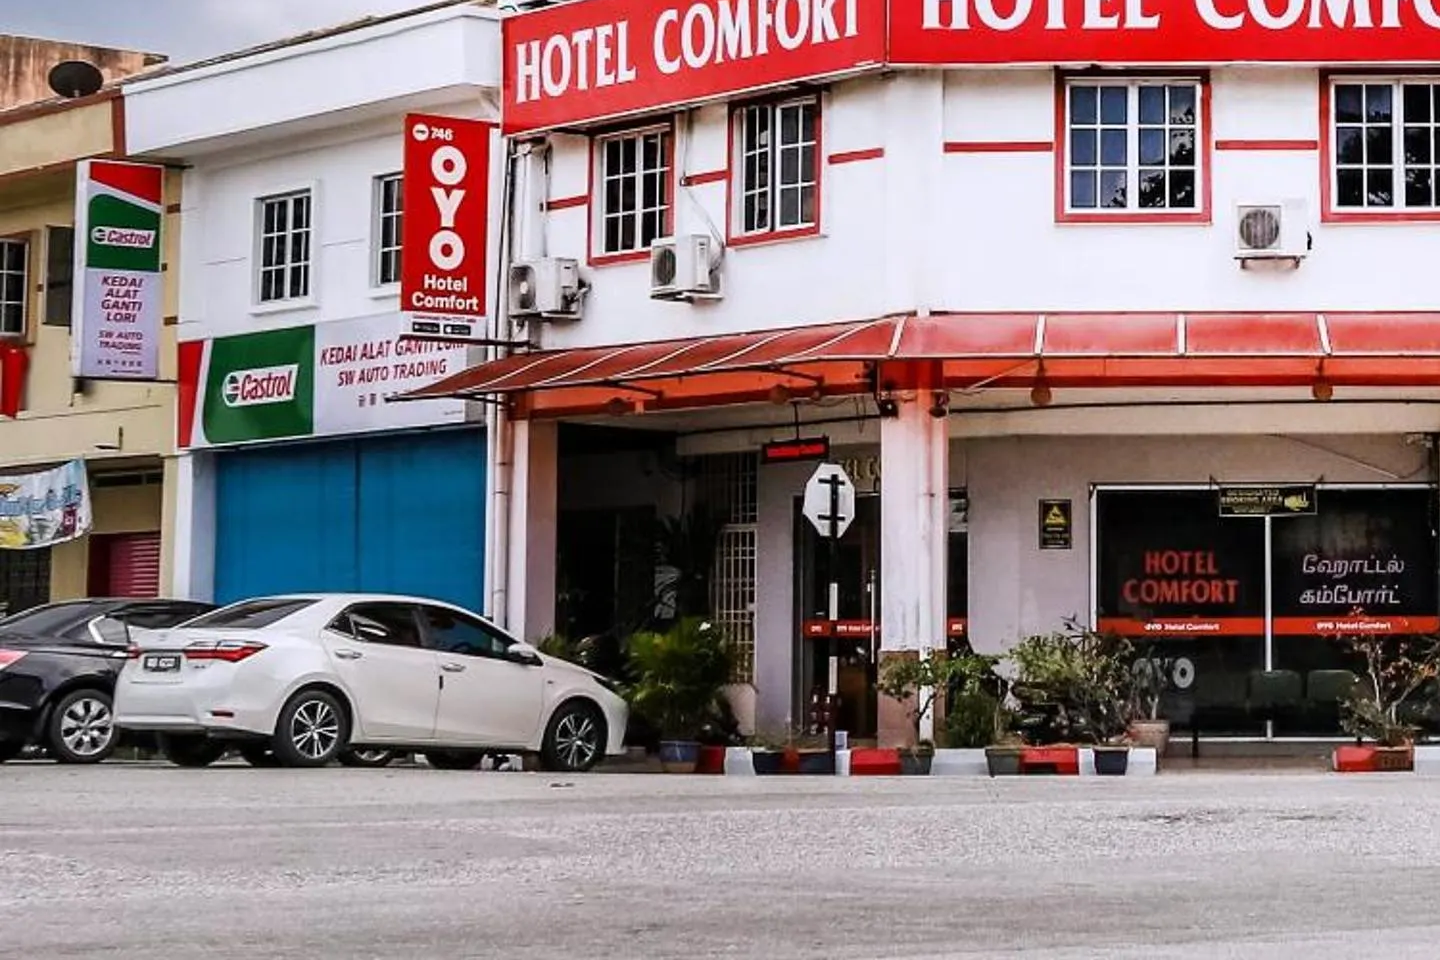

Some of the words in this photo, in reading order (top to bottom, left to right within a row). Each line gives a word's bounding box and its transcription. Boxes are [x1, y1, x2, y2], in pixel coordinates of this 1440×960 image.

[514, 19, 636, 104] HOTEL
[429, 145, 467, 271] OYO
[107, 229, 152, 245] Castrol
[101, 275, 143, 289] KEDAI
[423, 273, 468, 293] Hotel
[104, 288, 139, 300] ALAT
[411, 291, 479, 311] Comfort
[101, 299, 143, 313] GANTI
[106, 311, 137, 324] LORI
[116, 331, 143, 341] AUTO
[320, 344, 358, 366] KEDAI
[360, 339, 392, 361] ALAT
[337, 371, 355, 387] SW
[357, 365, 389, 384] AUTO
[392, 357, 448, 380] TRADING
[240, 370, 292, 401] Castrol
[1144, 550, 1219, 574] HOTEL
[1122, 578, 1240, 604] COMFORT
